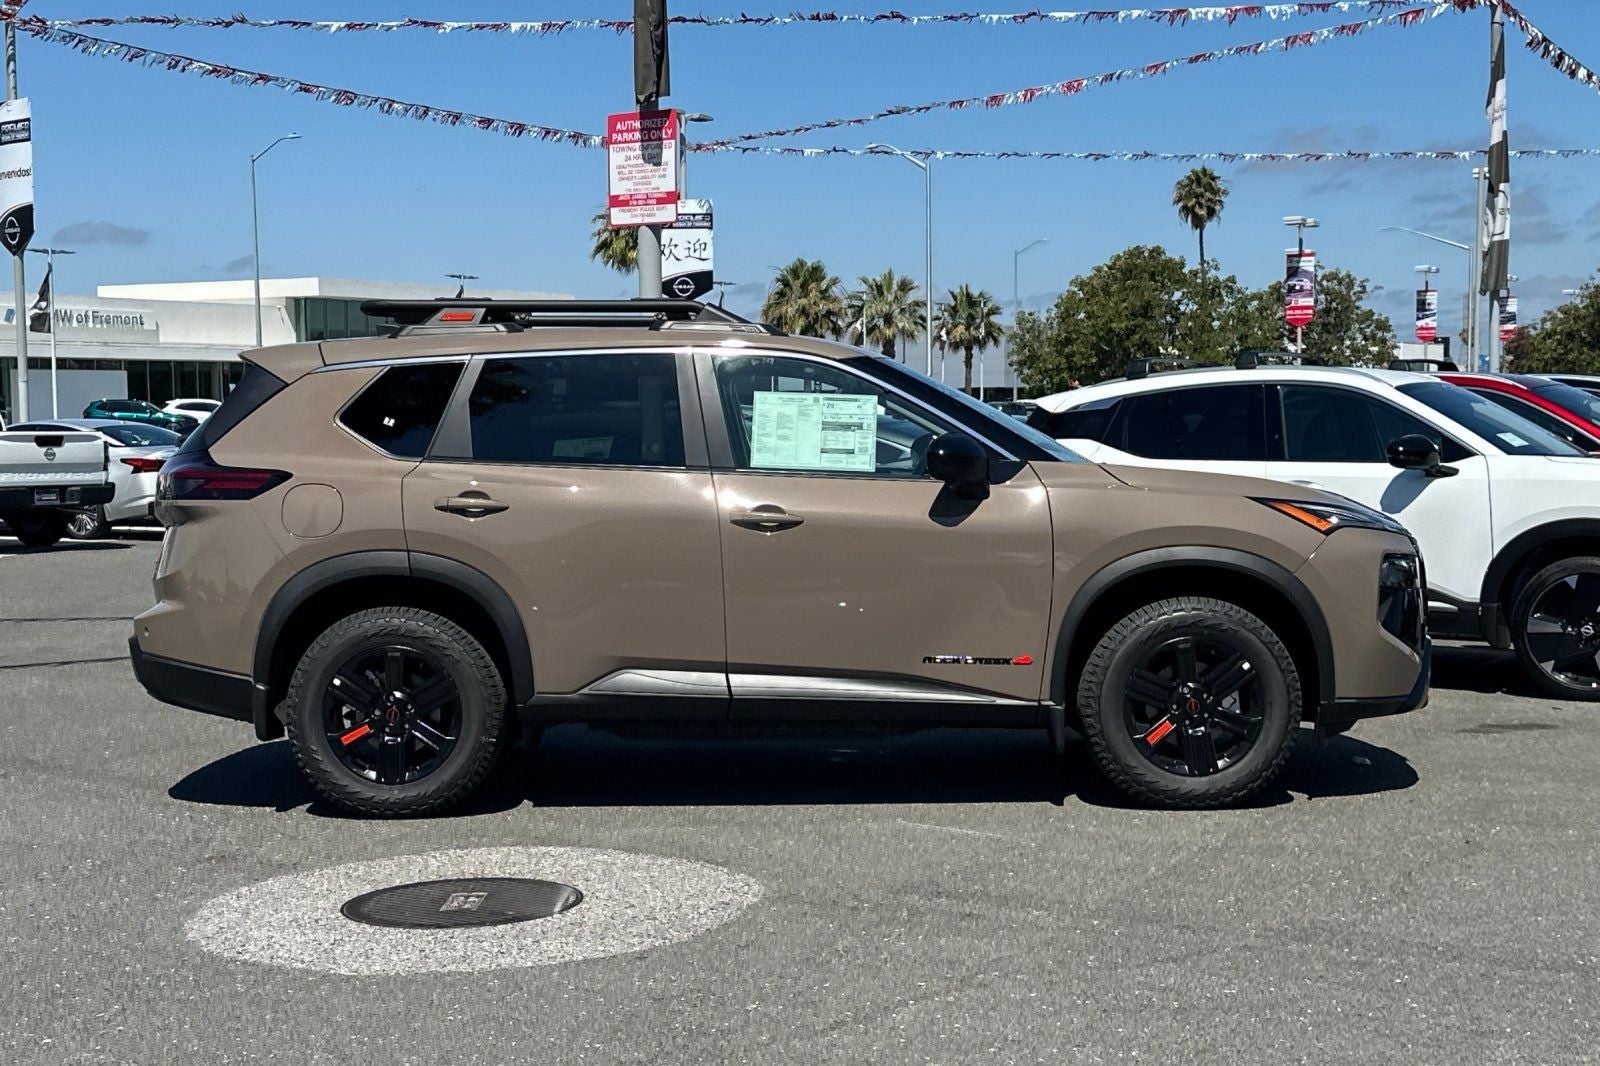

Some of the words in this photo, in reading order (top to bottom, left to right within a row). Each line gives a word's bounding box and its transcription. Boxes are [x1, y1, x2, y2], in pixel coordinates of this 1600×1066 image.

[615, 118, 669, 131] AUTHORIZED
[611, 130, 648, 142] PARKING
[650, 128, 673, 139] ONLY
[612, 144, 637, 153] TOWING
[638, 142, 673, 151] ENFORCED
[660, 237, 711, 261] 欢迎
[75, 310, 89, 324] of
[91, 310, 145, 326] Fremont
